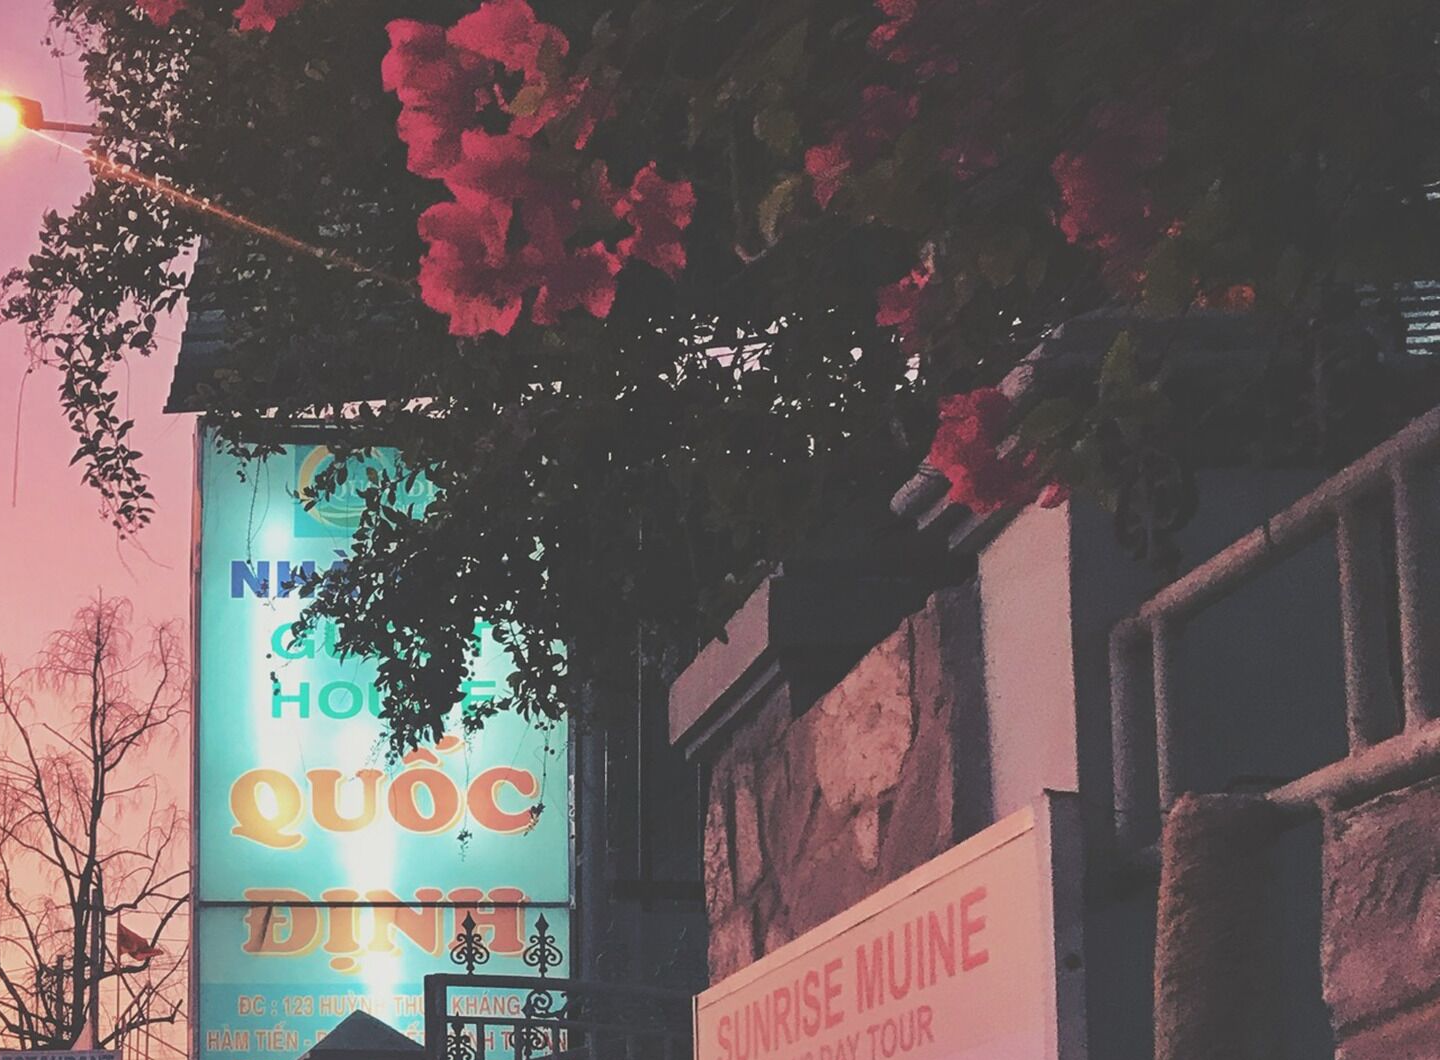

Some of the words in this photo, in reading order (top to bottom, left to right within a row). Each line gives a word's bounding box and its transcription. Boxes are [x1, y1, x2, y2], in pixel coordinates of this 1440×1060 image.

[271, 680, 497, 720] HOUE
[229, 735, 540, 849] QUỐC
[242, 887, 532, 972] ĐỊNH
[856, 885, 991, 1014] MUINE
[283, 994, 314, 1016] 123
